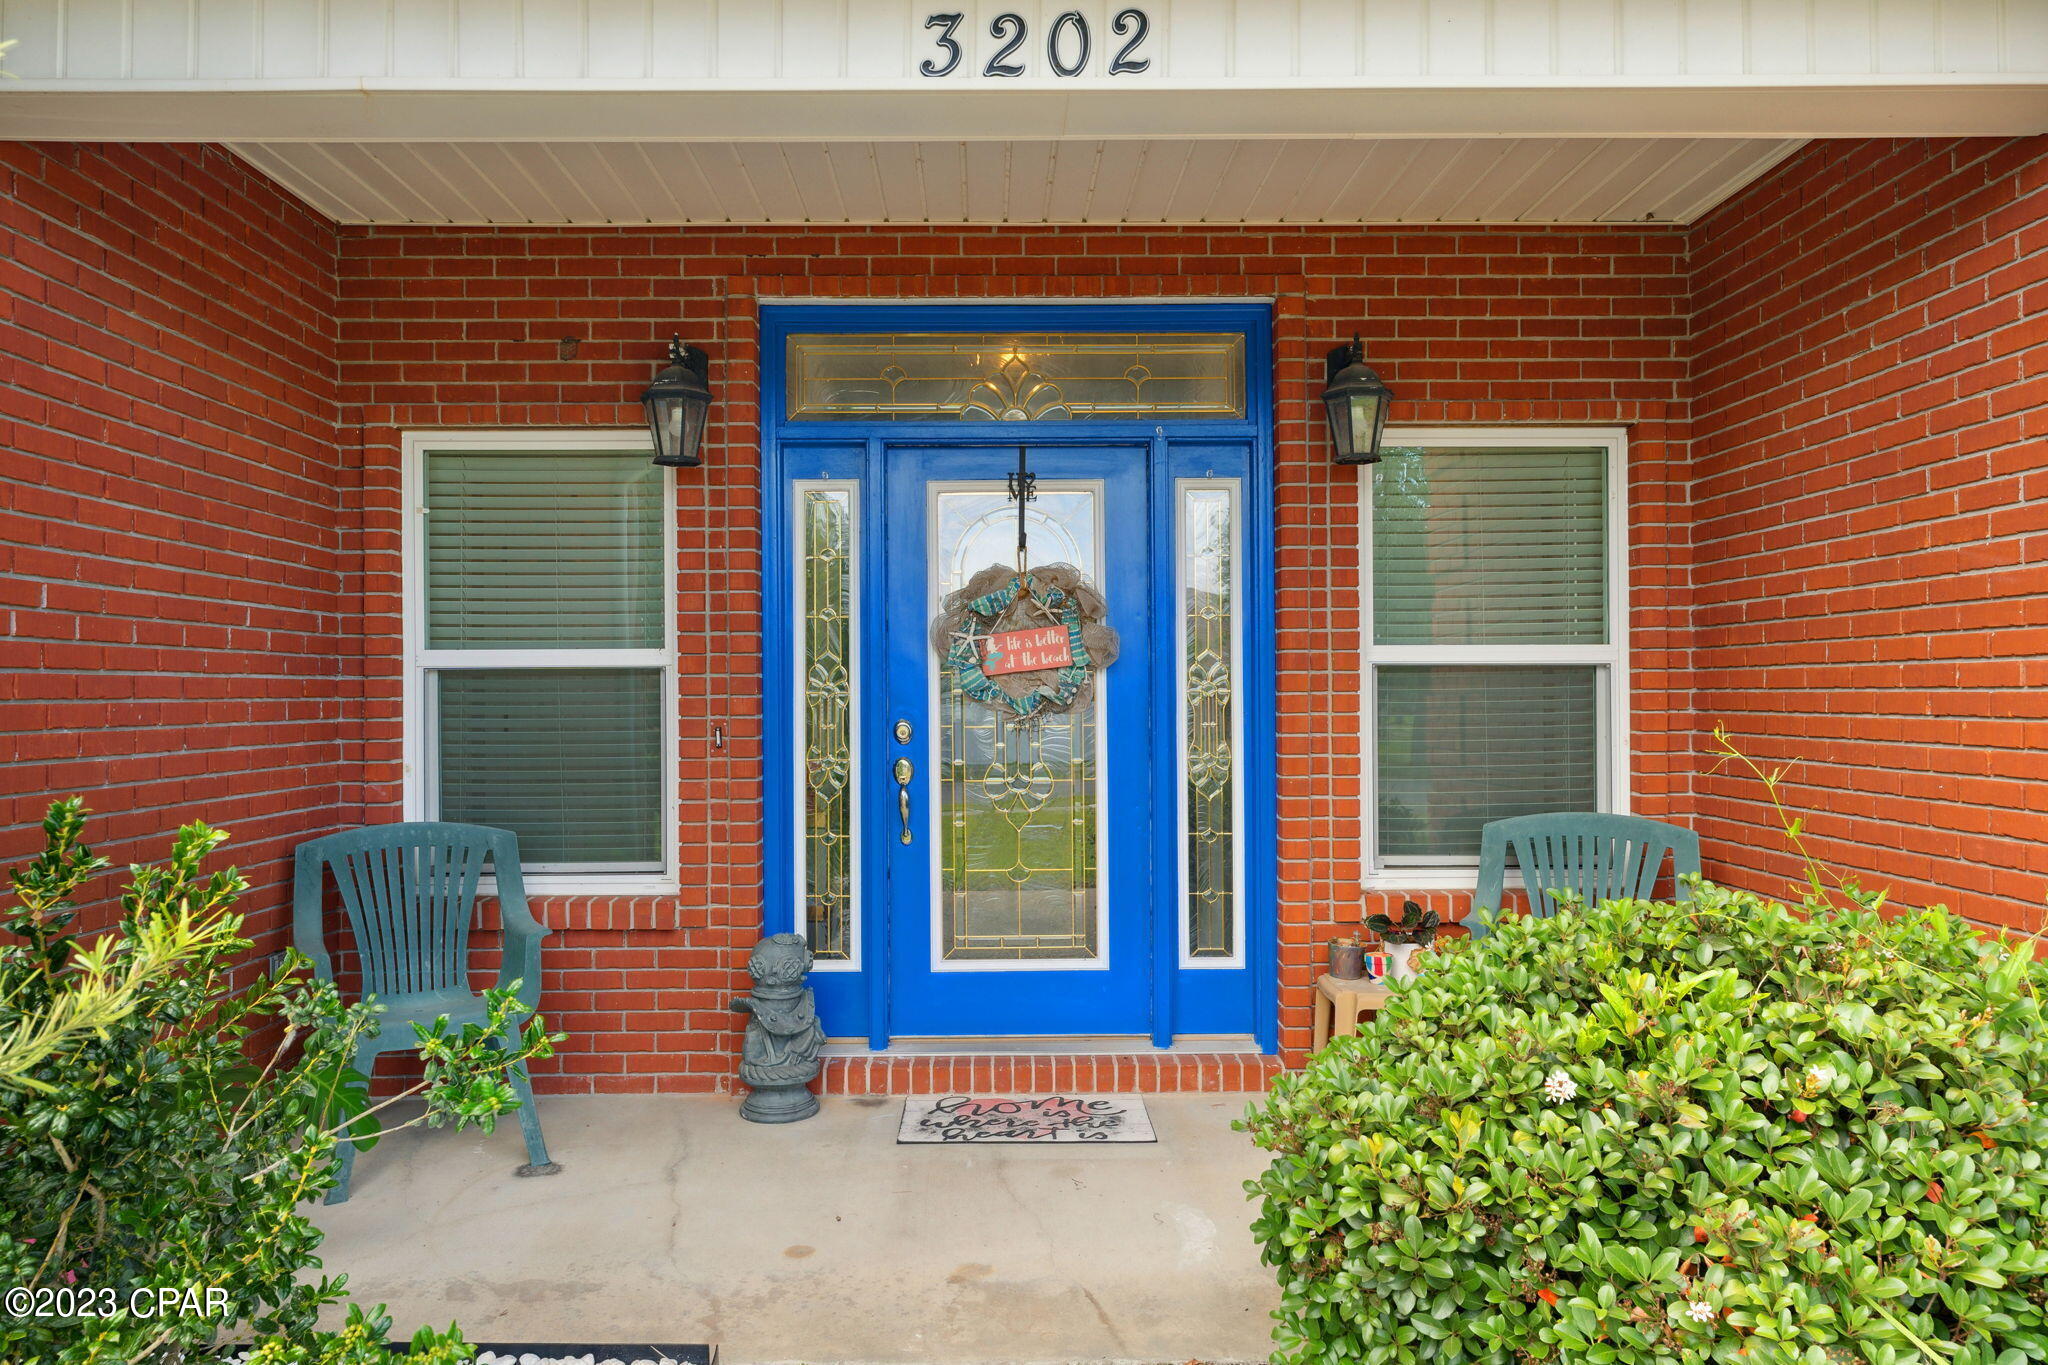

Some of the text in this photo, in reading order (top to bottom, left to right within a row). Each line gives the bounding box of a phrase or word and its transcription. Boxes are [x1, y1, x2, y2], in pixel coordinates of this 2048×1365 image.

[920, 8, 1151, 77] 3202
[1006, 629, 1065, 651] life is better
[1004, 646, 1070, 669] at the beach
[928, 1096, 1128, 1116] home
